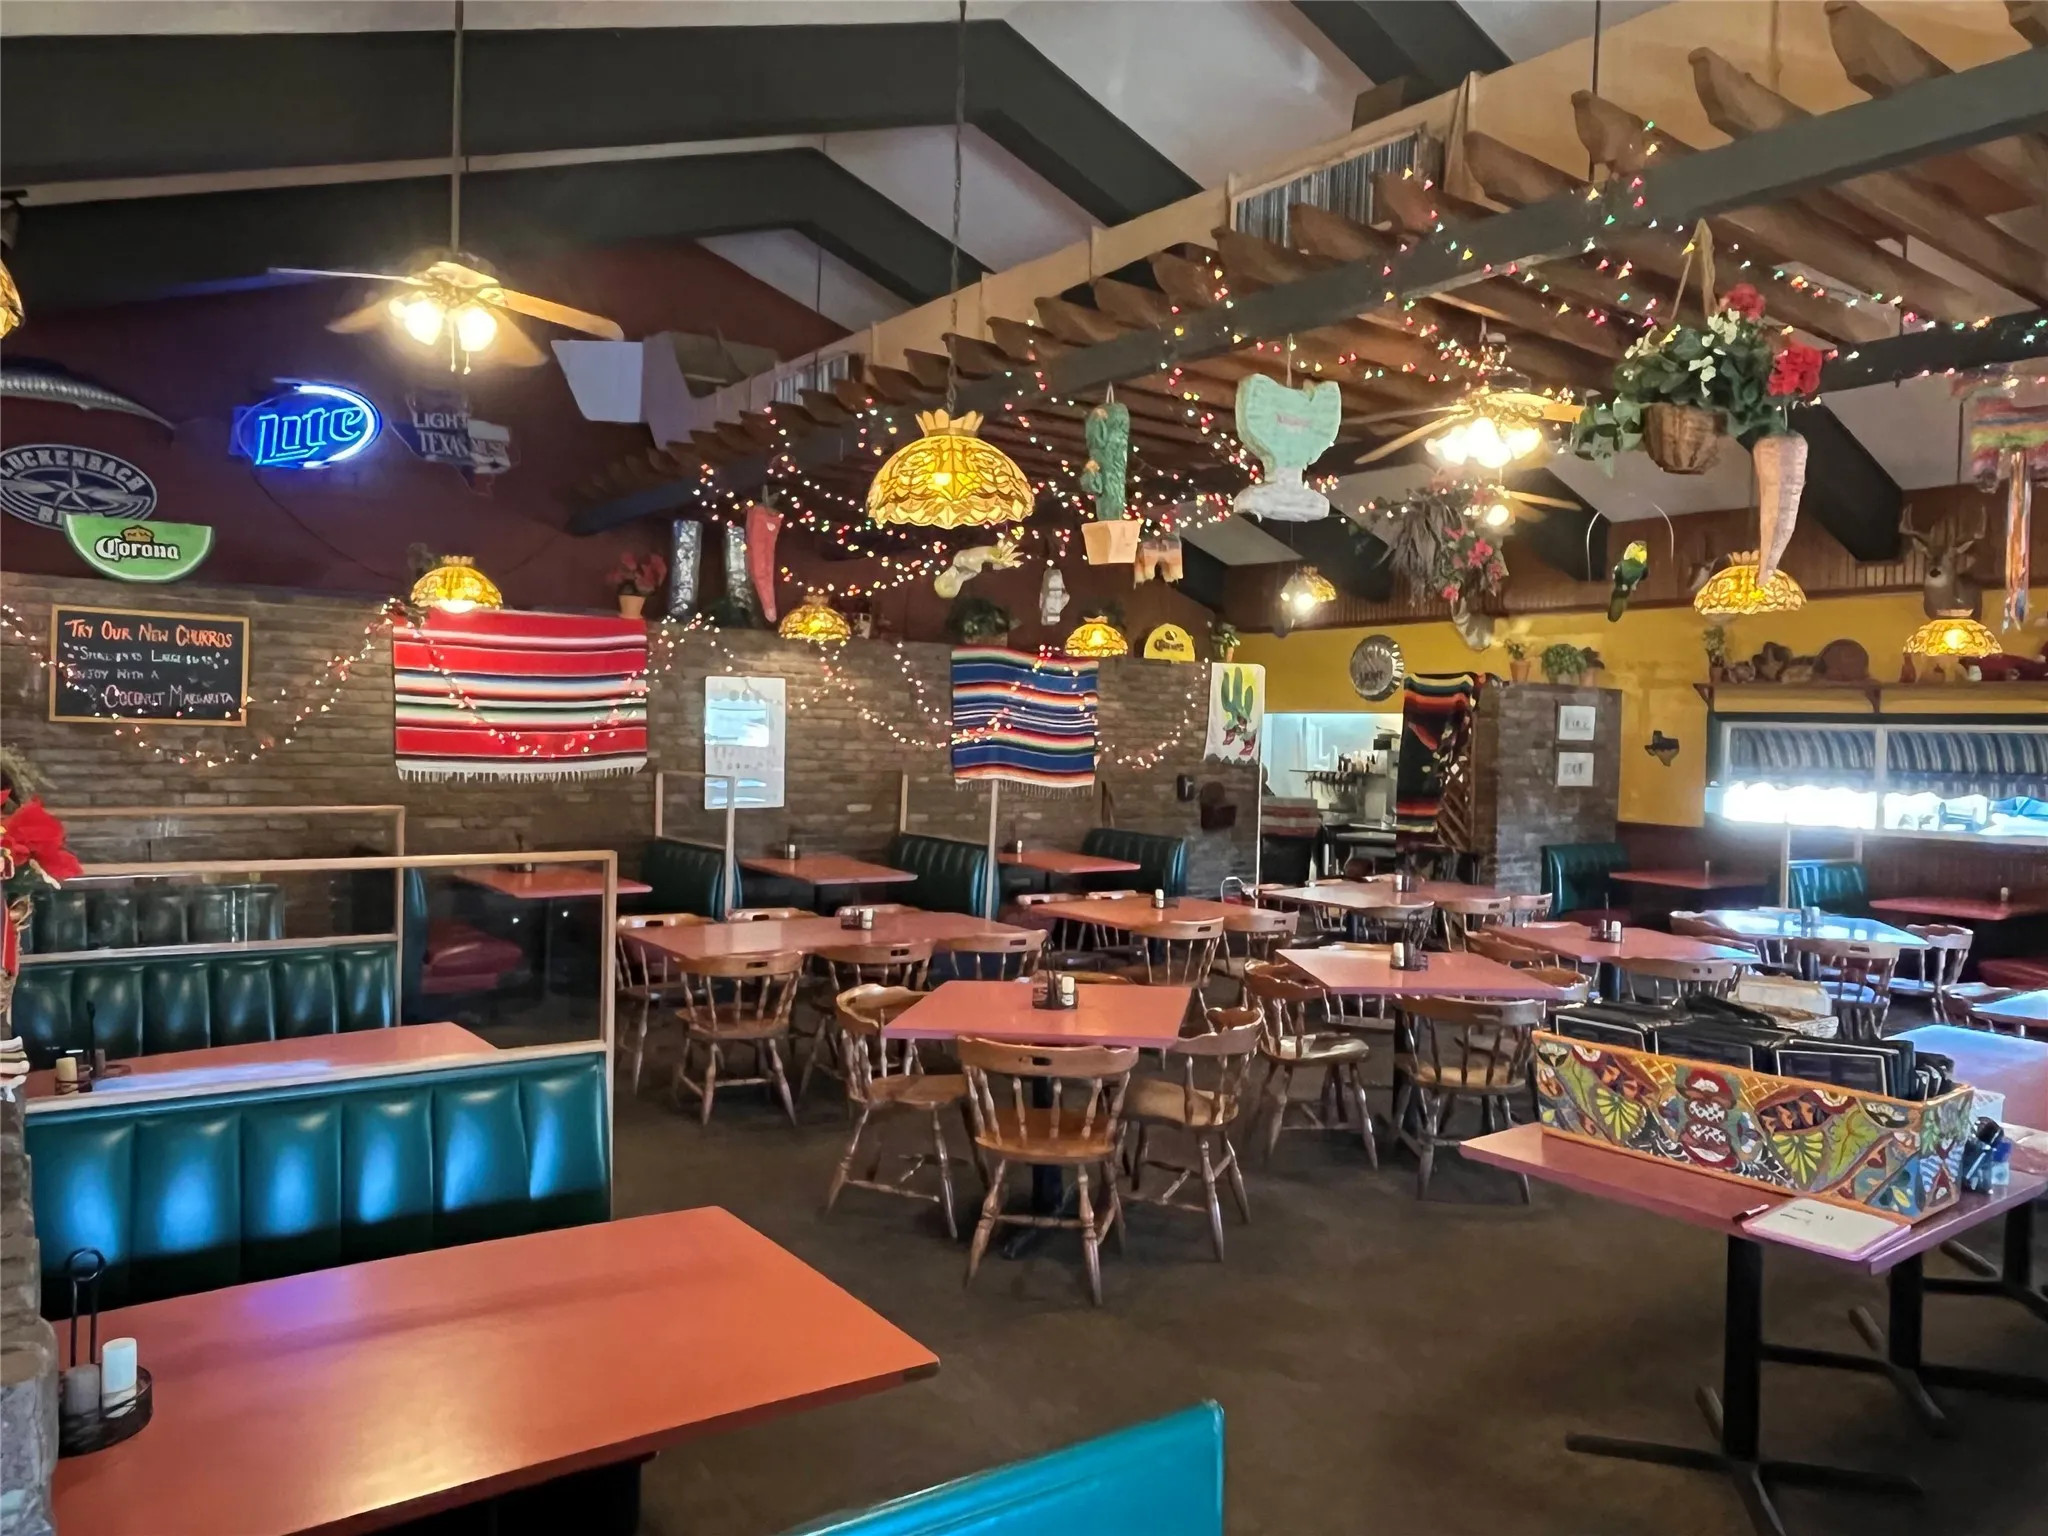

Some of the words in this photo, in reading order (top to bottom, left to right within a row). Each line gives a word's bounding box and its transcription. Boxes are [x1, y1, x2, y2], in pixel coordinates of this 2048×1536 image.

[412, 412, 468, 429] LIGHT
[254, 407, 364, 465] Lite
[0, 449, 147, 492] LUCKENBACH
[95, 537, 180, 561] Corona
[64, 618, 94, 639] TRY
[101, 620, 133, 642] OUR
[138, 622, 170, 643] NEW
[175, 624, 233, 648] CHURROS
